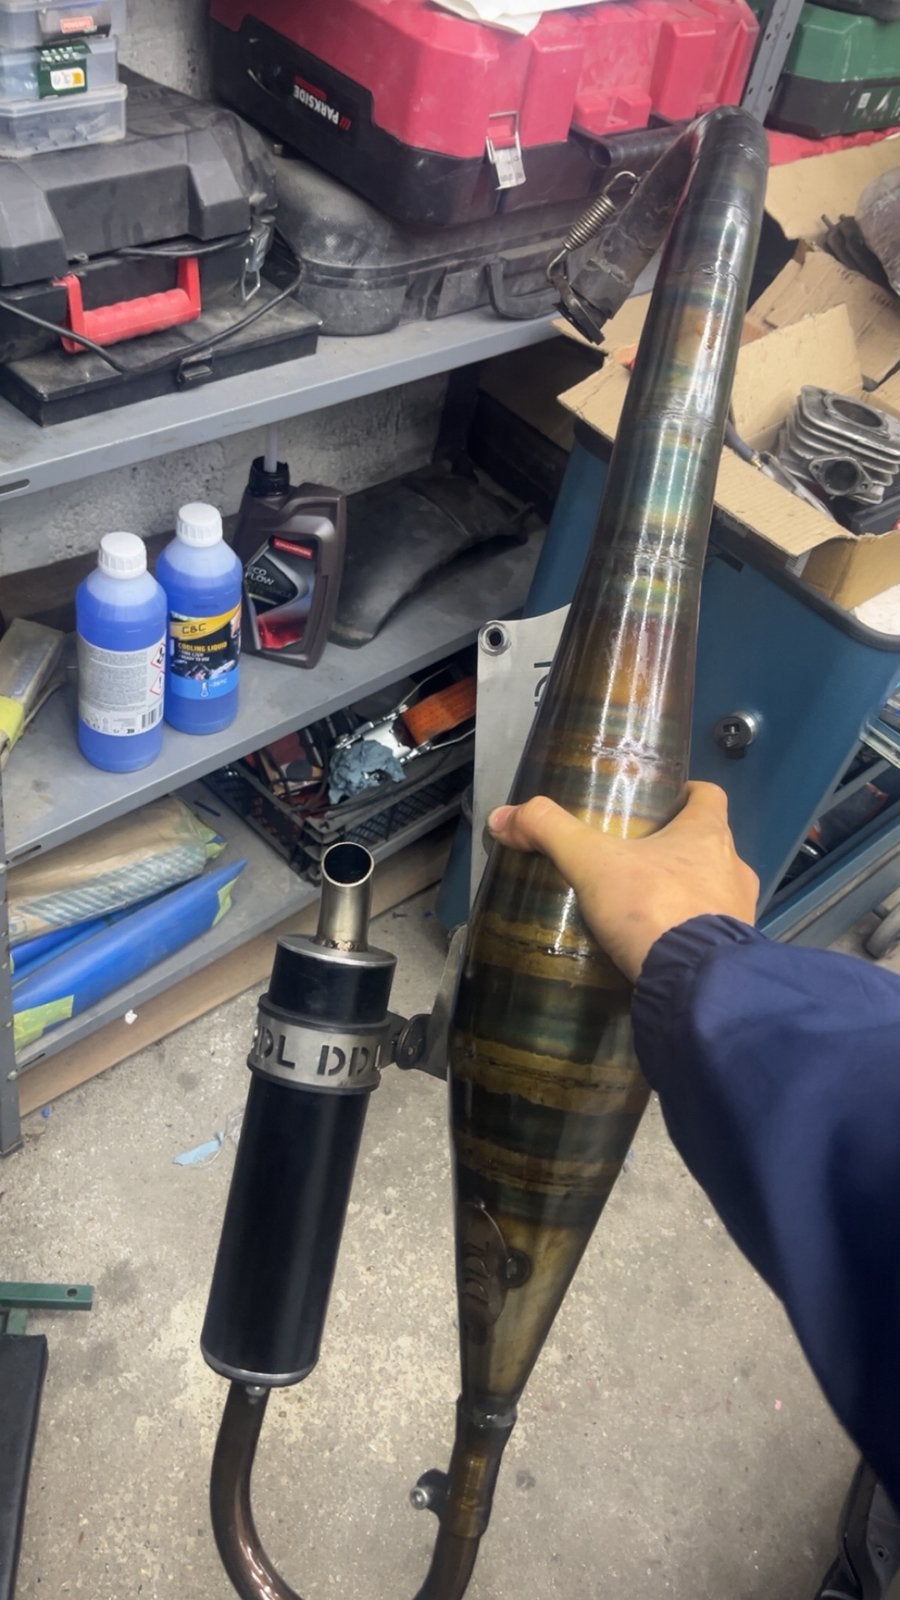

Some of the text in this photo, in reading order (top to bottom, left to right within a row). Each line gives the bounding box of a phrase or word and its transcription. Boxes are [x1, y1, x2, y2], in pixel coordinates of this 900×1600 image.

[293, 84, 340, 125] PARKSIDE
[182, 623, 207, 634] C&C
[178, 641, 228, 653] COOLING LIQUID
